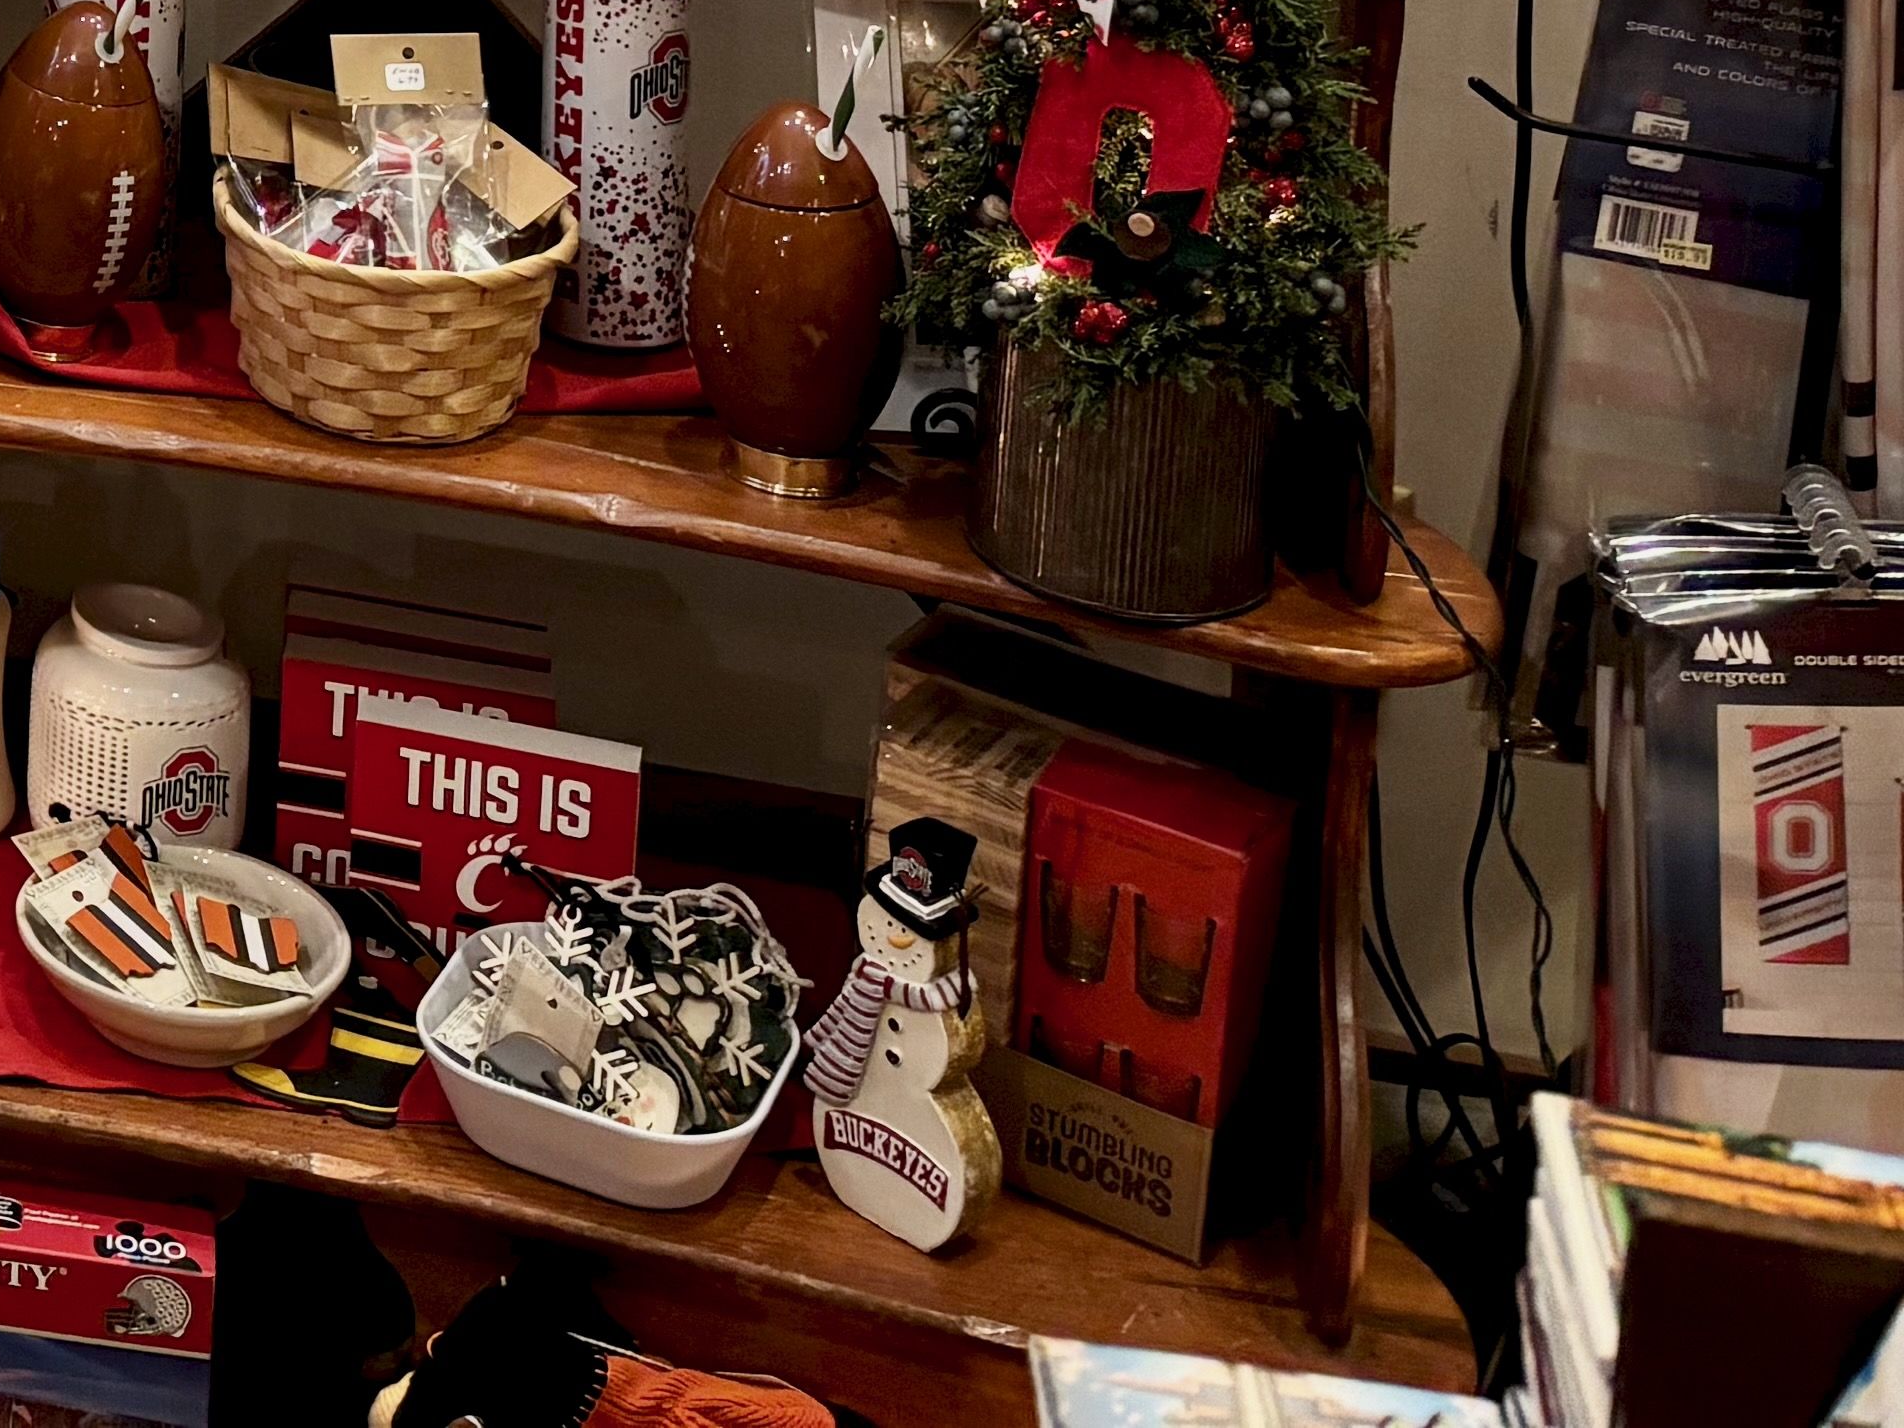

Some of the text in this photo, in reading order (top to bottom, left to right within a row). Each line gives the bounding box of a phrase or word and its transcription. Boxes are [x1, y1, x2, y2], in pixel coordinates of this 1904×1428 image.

[1626, 20, 1784, 58] SPECIAL TREATED
[1672, 61, 1789, 91] AND COLORS
[1679, 668, 1787, 689] evergreen
[1794, 654, 1857, 667] DOUBLE
[398, 745, 593, 840] THIS IS
[831, 1111, 947, 1200] BUCKEYES
[1029, 1102, 1174, 1180] STUMBLING
[1024, 1127, 1173, 1218] BLOCKS
[104, 1232, 188, 1261] 1000
